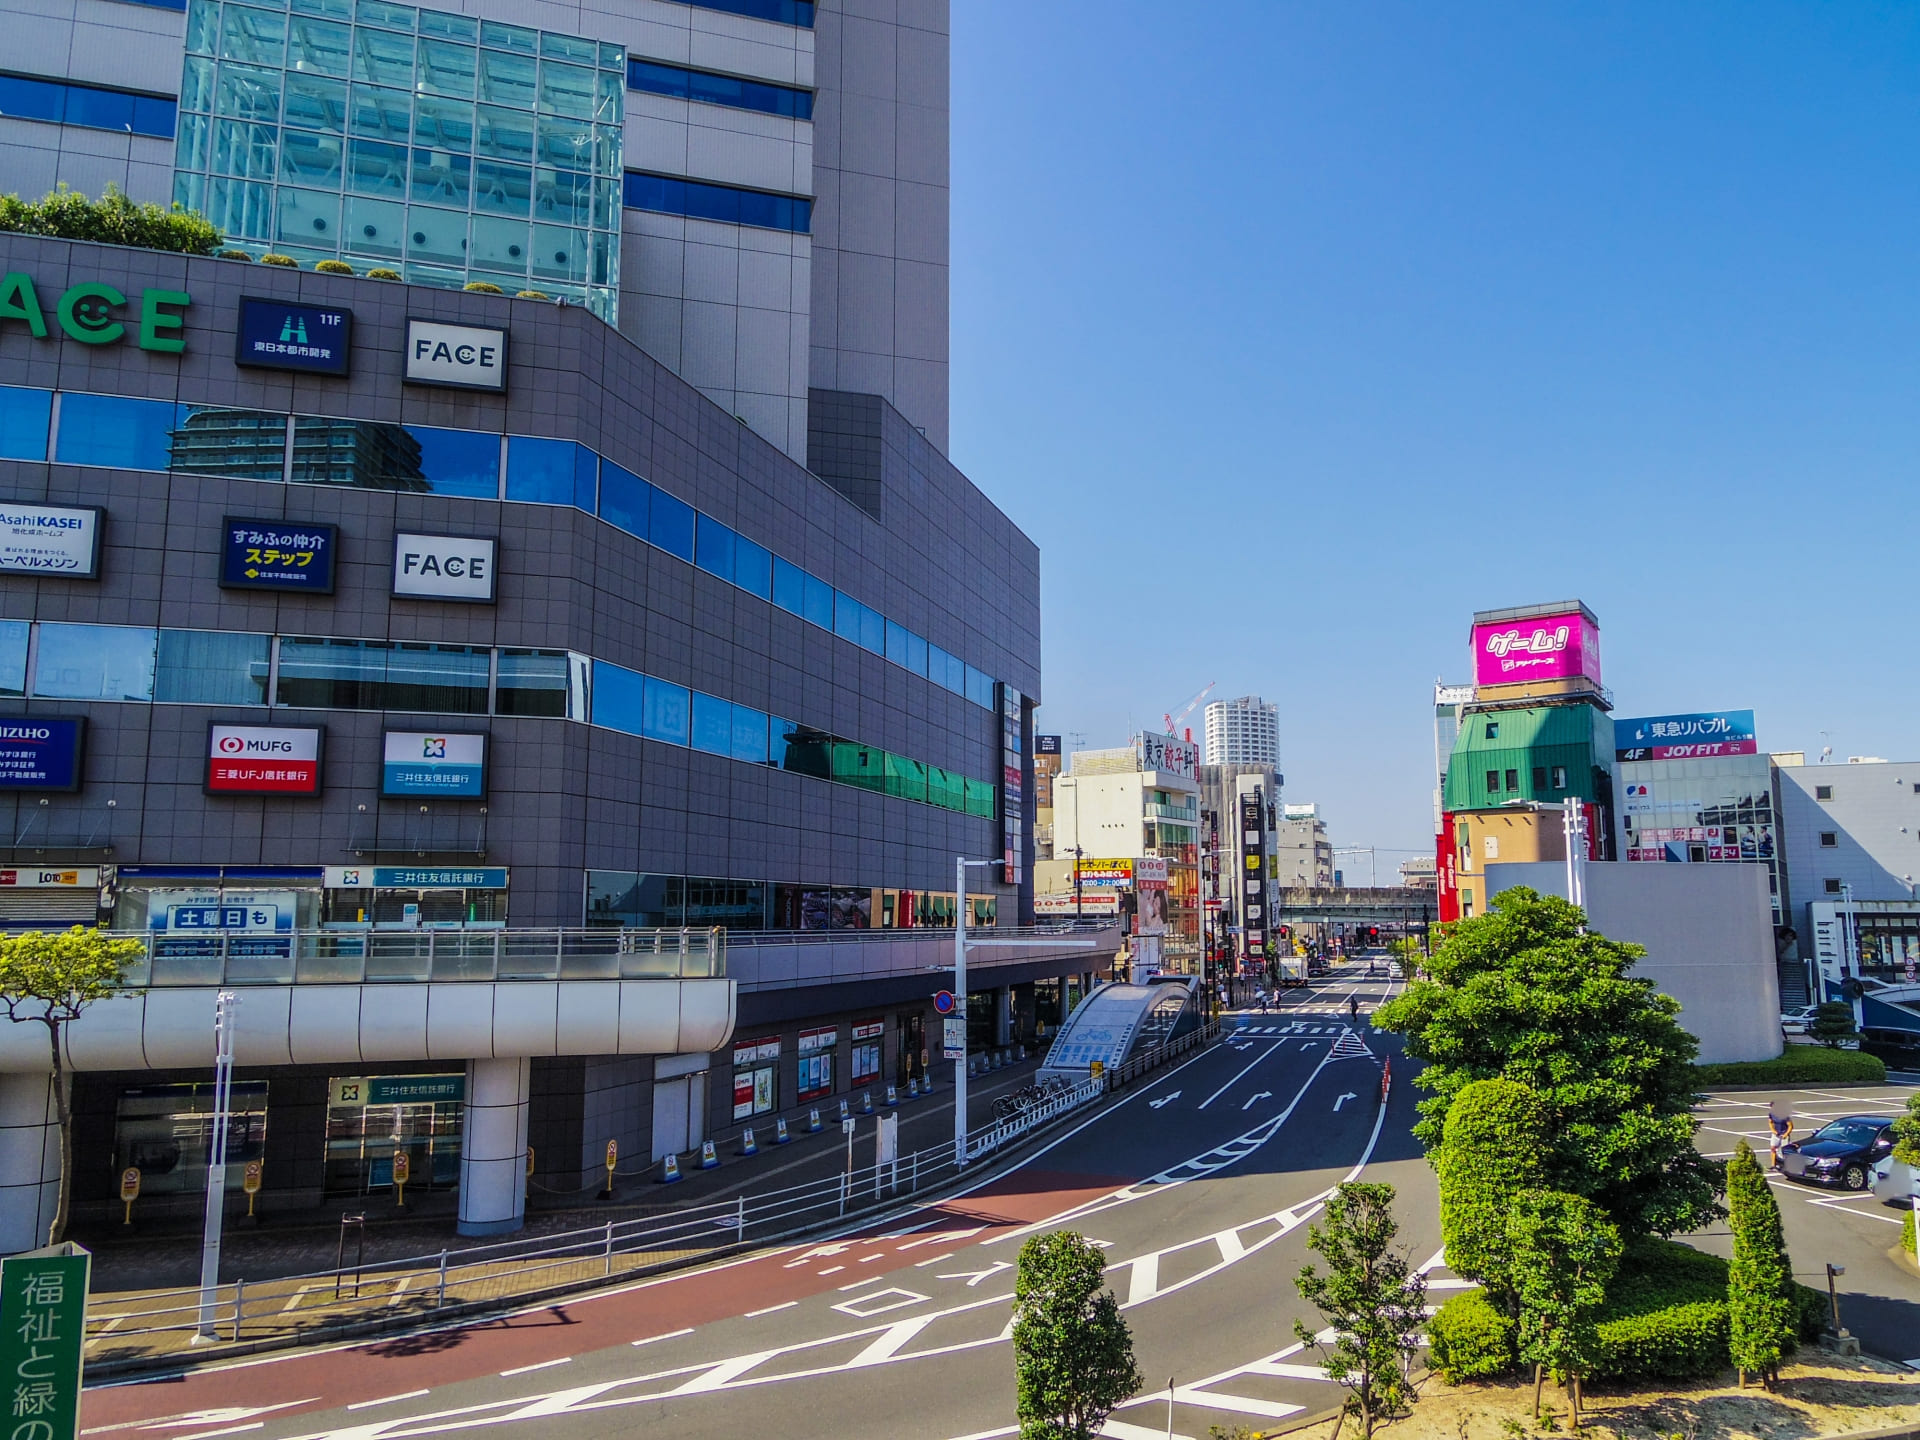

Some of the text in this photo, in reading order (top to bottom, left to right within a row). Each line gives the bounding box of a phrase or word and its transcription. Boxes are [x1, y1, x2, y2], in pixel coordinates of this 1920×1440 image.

[320, 314, 341, 326] 11F
[254, 341, 331, 359] 東日本都市開発
[415, 339, 495, 368] FACE
[233, 530, 325, 549] すみふの仲介
[245, 548, 313, 567] ステップ
[404, 552, 485, 579] FACE
[0, 726, 50, 739] IZUHO
[1652, 718, 1731, 737] 東急リバブル
[247, 740, 292, 752] MUFG
[1624, 748, 1645, 760] 4F
[1144, 735, 1194, 778] 東京餃子軒
[216, 769, 308, 781] 三菱UFJ信託銀行
[395, 773, 469, 783] 三井住友信託銀行
[394, 872, 484, 884] 三井住友信託銀行
[181, 910, 267, 926] 土曜日も
[1816, 921, 1837, 964] hairdo
[381, 1085, 455, 1096] 三井住友信託銀行
